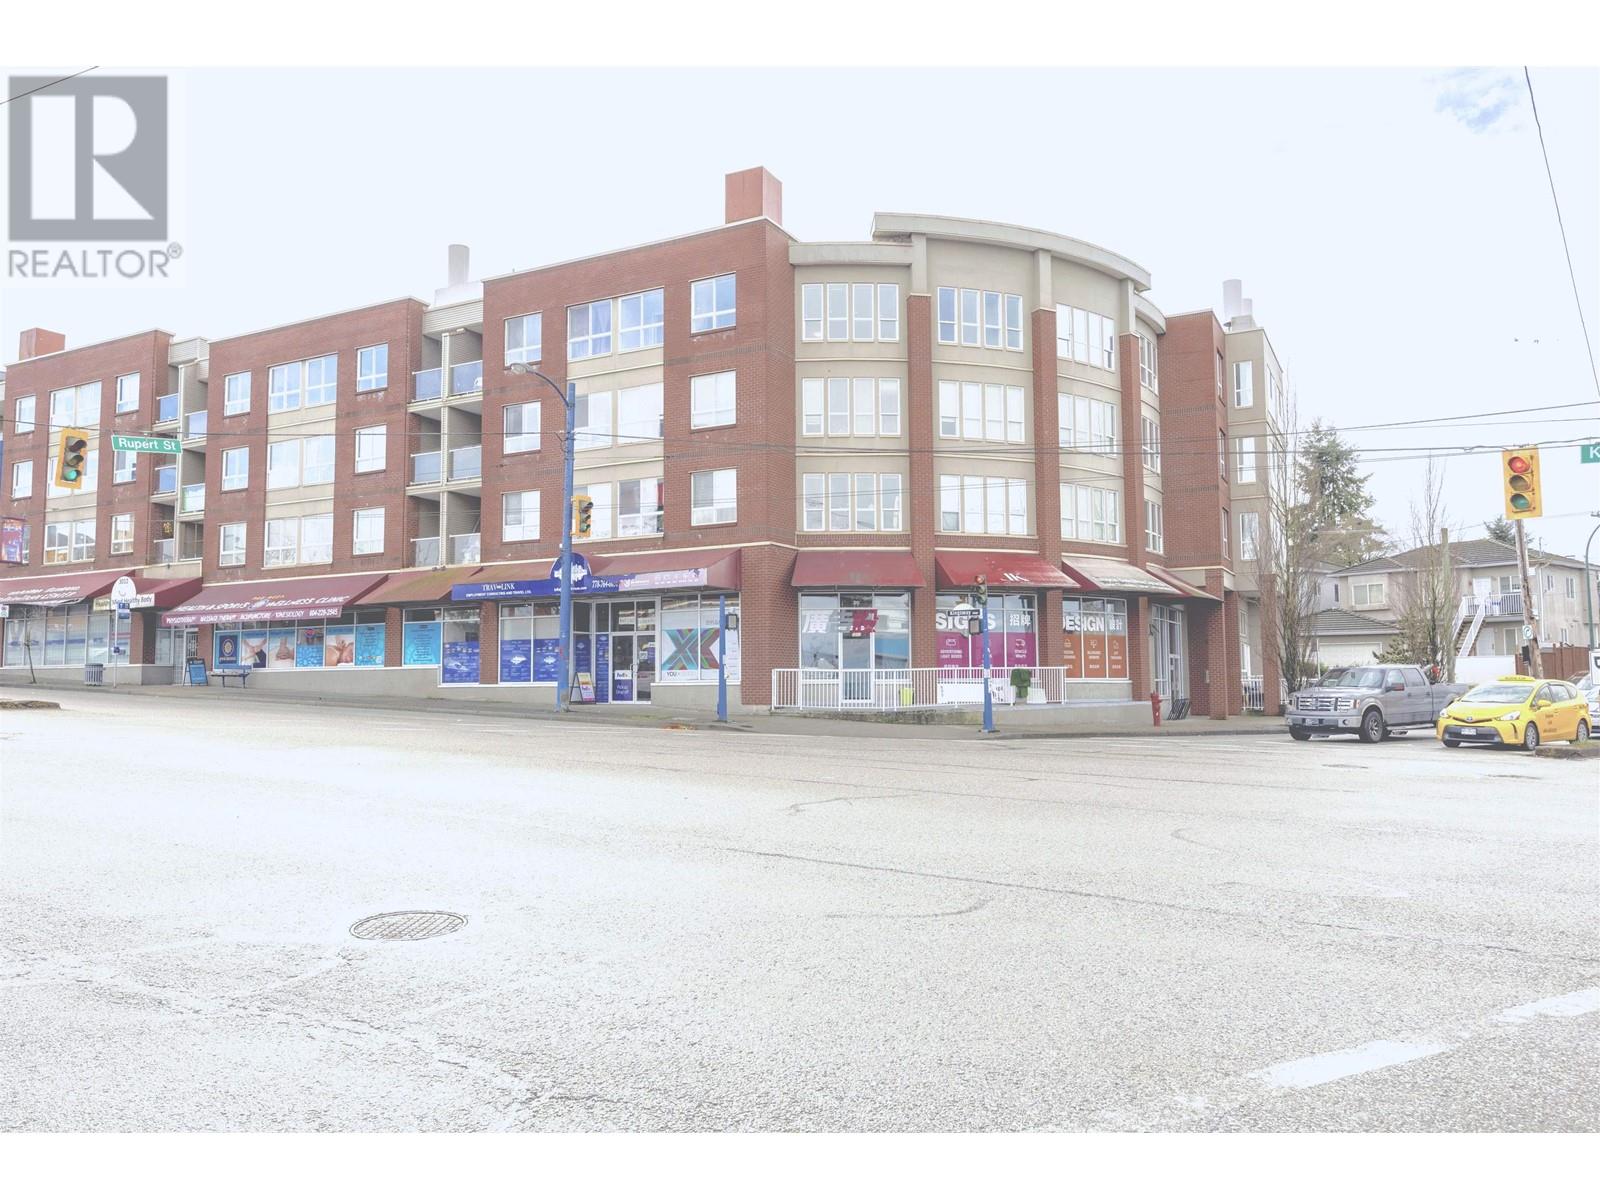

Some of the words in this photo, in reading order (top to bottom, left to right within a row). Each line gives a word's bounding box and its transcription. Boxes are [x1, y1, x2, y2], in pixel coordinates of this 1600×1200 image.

[118, 438, 158, 449] Rupert
[163, 441, 176, 450] St
[936, 613, 996, 630] SIGS
